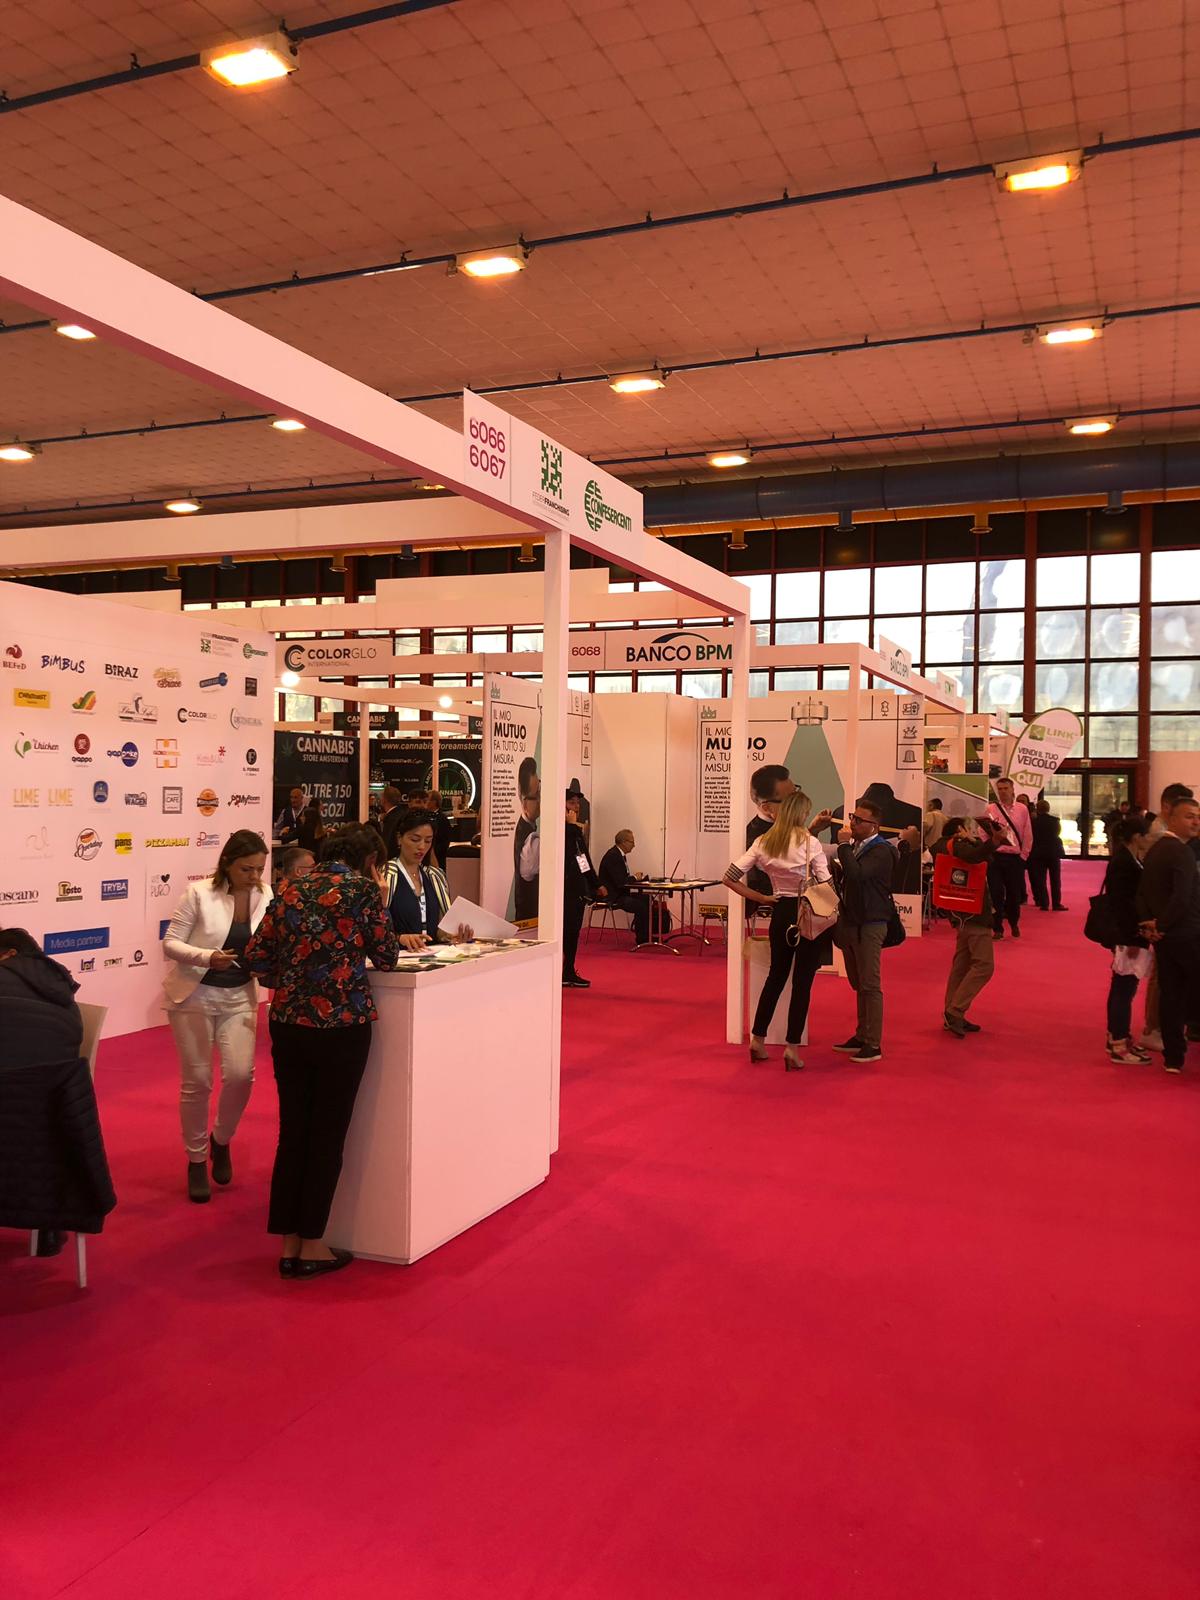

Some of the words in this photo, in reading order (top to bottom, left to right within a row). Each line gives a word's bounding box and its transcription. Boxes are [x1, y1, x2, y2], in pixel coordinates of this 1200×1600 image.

[469, 417, 506, 454] 6066
[469, 444, 506, 480] 6067
[307, 647, 377, 660] COLORGLO
[571, 646, 601, 656] 6068
[626, 645, 691, 663] BANCO
[695, 644, 733, 661] BPM
[346, 715, 386, 723] CANABIS
[499, 710, 512, 722] MIO
[493, 722, 527, 740] MUTUO
[705, 727, 712, 736] IL
[1046, 728, 1074, 740] LINK
[296, 736, 355, 755] CANNABIS
[493, 739, 501, 751] FA
[705, 737, 767, 750] MUO
[302, 754, 319, 762] STORE
[320, 754, 349, 763] AMSTERDAM
[493, 754, 515, 765] MISURA
[705, 752, 716, 761] FA
[752, 752, 765, 761] SU
[1017, 747, 1038, 757] VENDI
[1044, 752, 1059, 761] TUO
[704, 763, 731, 773] MISU
[1017, 754, 1057, 771] VEICOLO
[1016, 772, 1041, 786] QUI
[334, 784, 352, 799] 150
[320, 802, 346, 818] GOZI
[0, 890, 39, 901] oscano
[898, 905, 913, 914] PM
[50, 938, 76, 949] Media
[77, 935, 103, 948] partner
